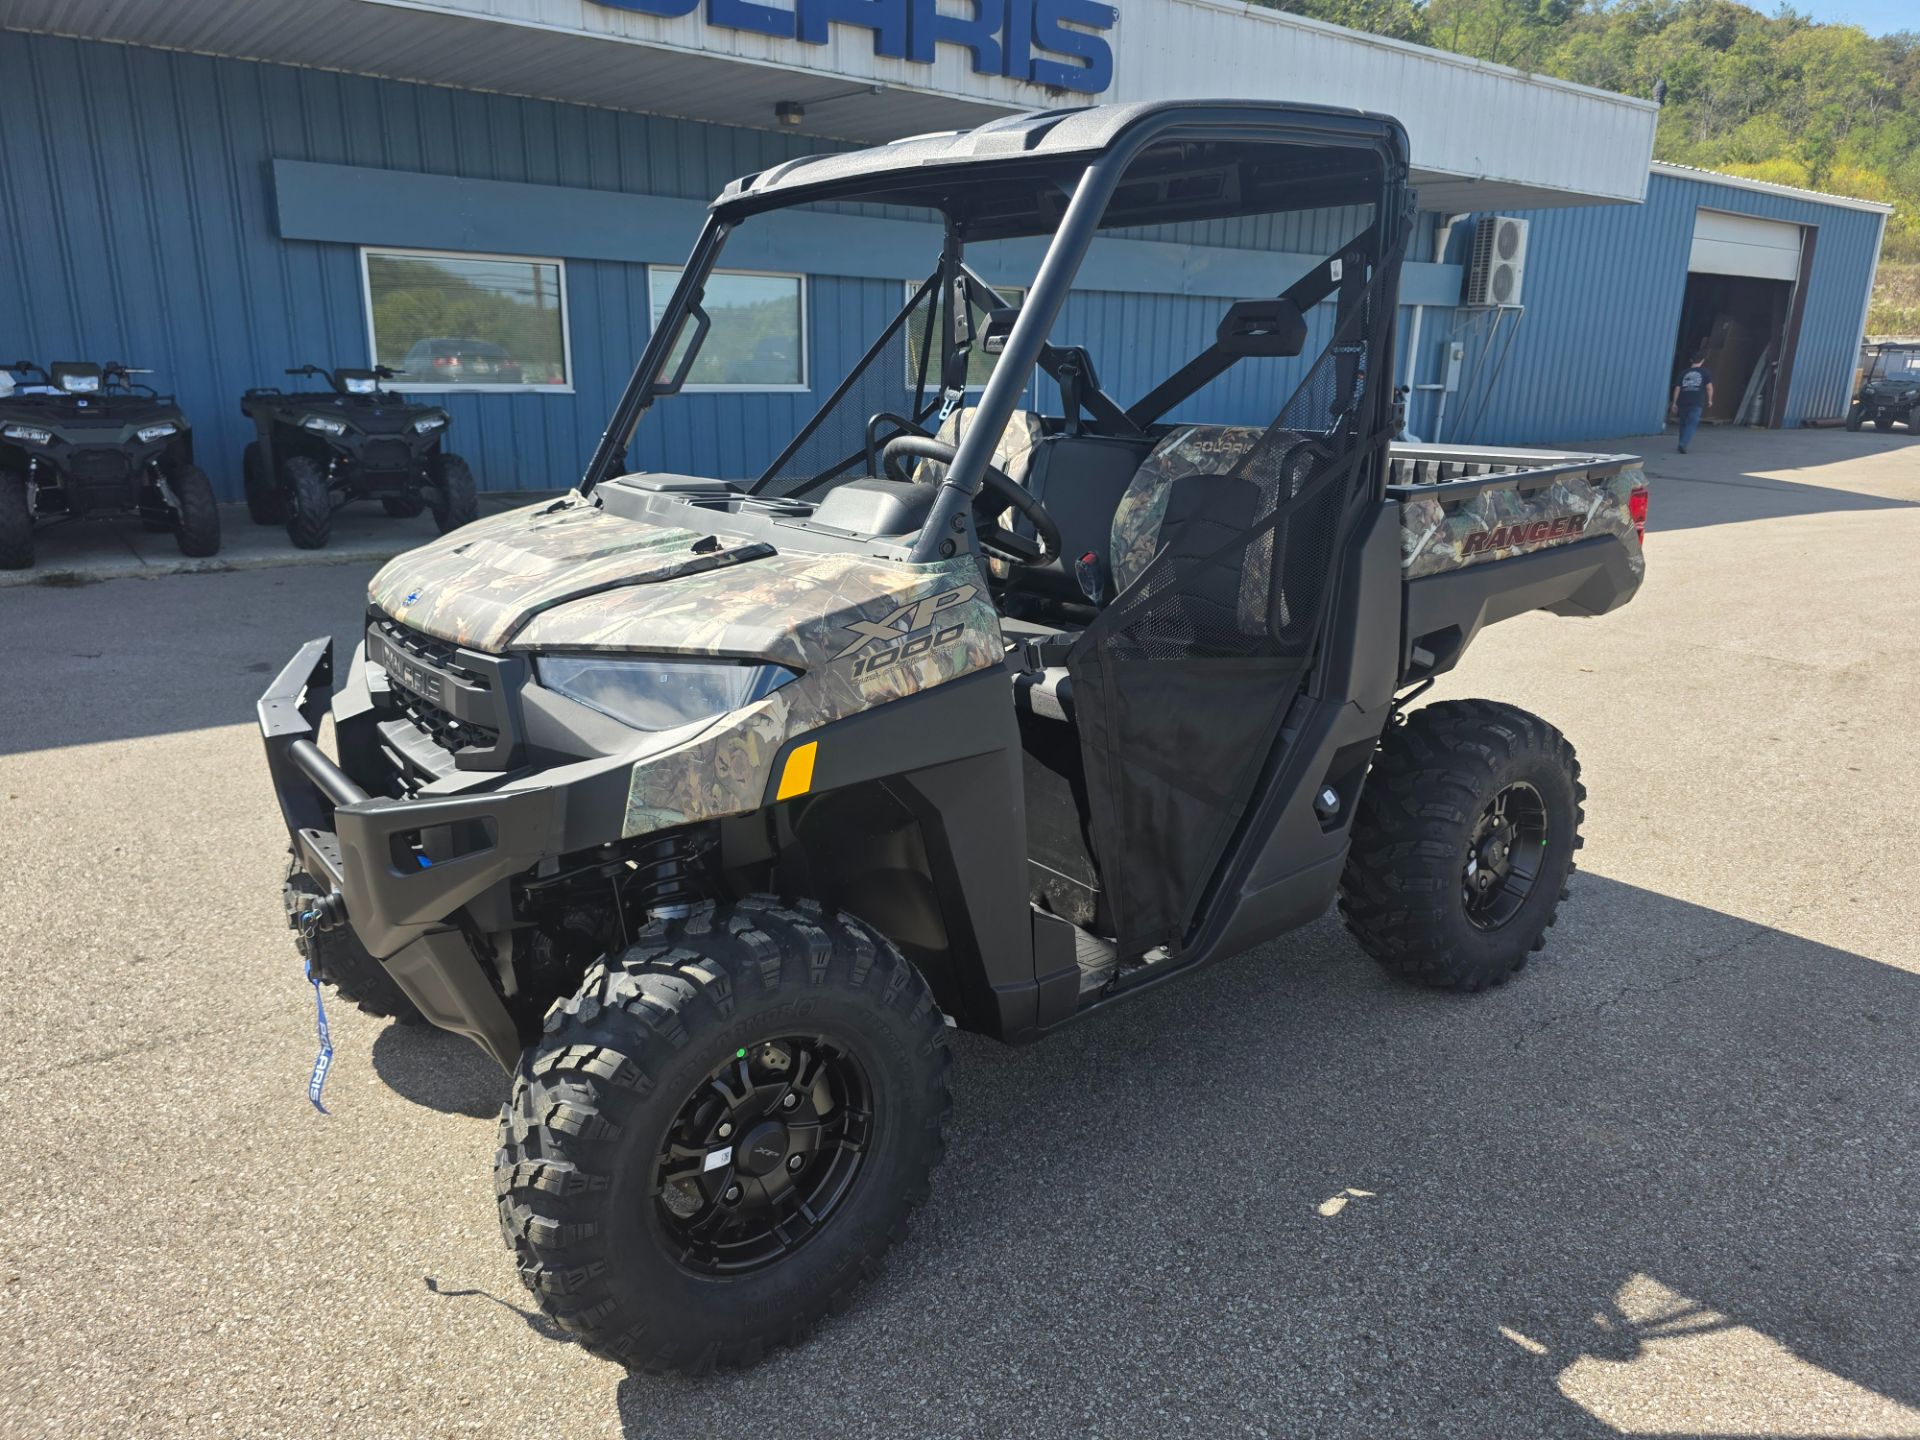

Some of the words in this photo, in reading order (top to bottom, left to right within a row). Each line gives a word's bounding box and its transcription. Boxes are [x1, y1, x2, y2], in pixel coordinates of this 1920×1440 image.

[1461, 513, 1588, 557] RANGER
[825, 583, 980, 664] XP
[853, 622, 965, 678] 1000
[310, 1021, 333, 1101] POLARIS
